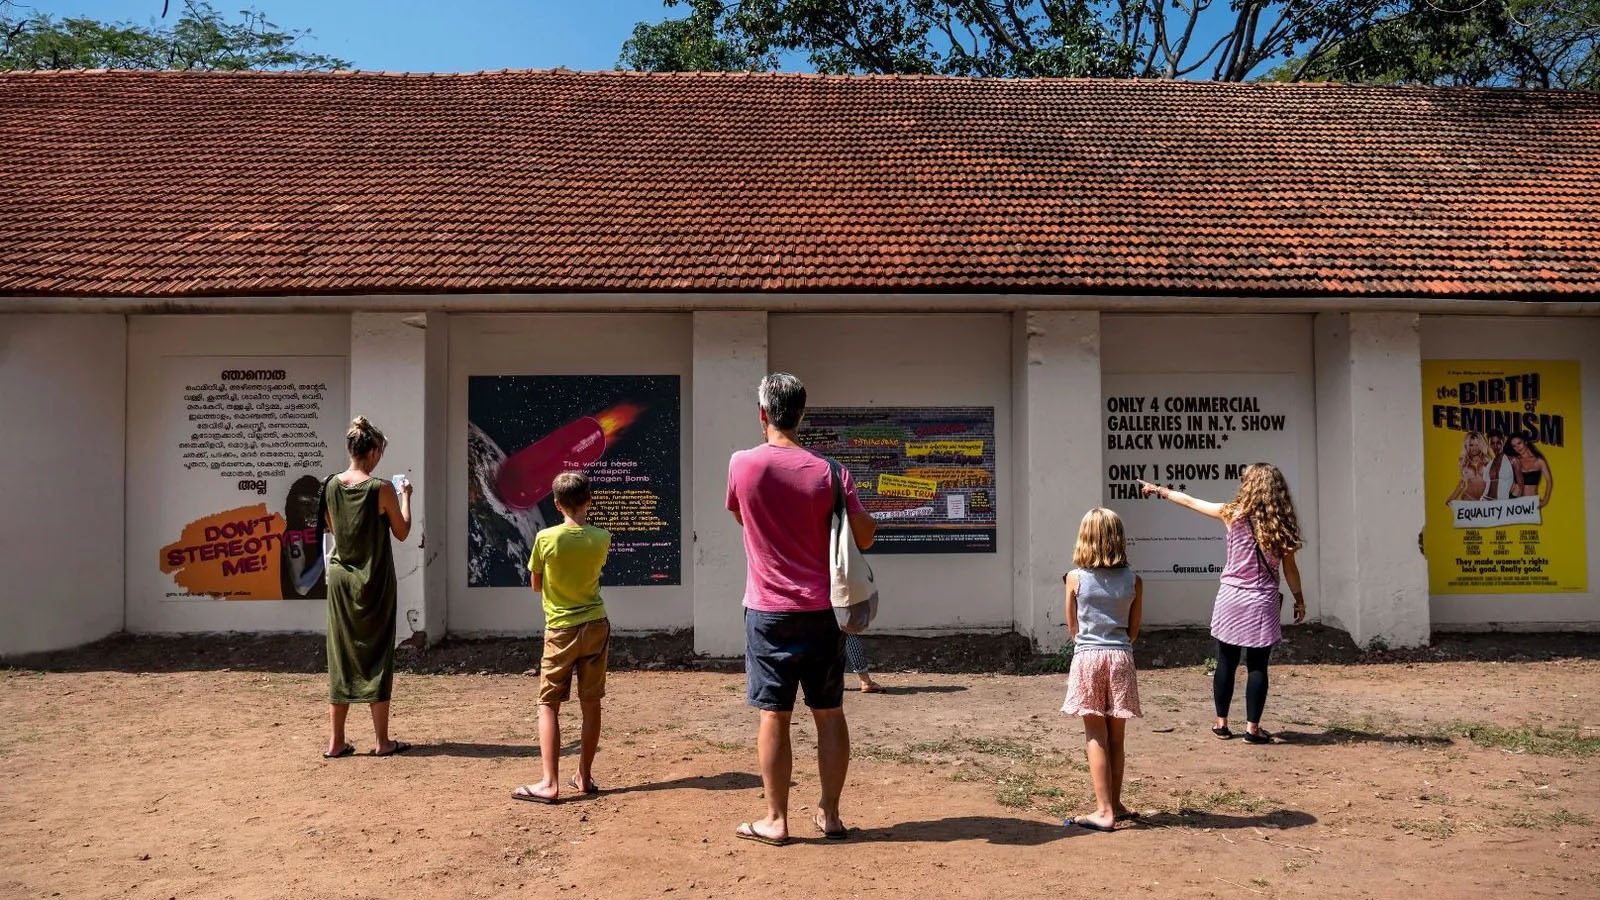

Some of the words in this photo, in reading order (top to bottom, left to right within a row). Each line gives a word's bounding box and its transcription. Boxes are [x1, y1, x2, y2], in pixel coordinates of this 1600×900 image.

[222, 369, 286, 380] ഞാനൊരു
[1436, 384, 1458, 400] the
[1458, 372, 1541, 406] BIRTH
[1107, 397, 1145, 413] ONLY
[1150, 397, 1160, 413] 4
[1164, 397, 1260, 413] COMMERCIAL
[1524, 401, 1538, 413] of
[1107, 415, 1182, 431] GALLERIES
[1187, 415, 1203, 431] IN
[1208, 415, 1237, 431] N.Y.
[1241, 415, 1286, 431] SHOW
[1432, 404, 1565, 449] FEMINISM
[1107, 433, 1154, 450] BLACK
[563, 460, 580, 468] The
[582, 460, 607, 468] world
[610, 460, 639, 468] needs
[588, 475, 623, 484] strogen
[624, 475, 651, 483] Bomb
[593, 468, 631, 477] weapon:
[1108, 464, 1147, 481] ONLY
[1153, 464, 1160, 481] 1
[1166, 464, 1220, 481] SHOWS
[238, 480, 267, 494] അല്ല
[1457, 506, 1503, 521] EQUALITY
[1506, 501, 1535, 517] NOW!
[167, 528, 319, 567] STEREOTYPE
[222, 555, 267, 577] ME!
[1455, 558, 1472, 567] They
[1495, 557, 1527, 565] women's
[1528, 557, 1549, 567] rights
[1461, 565, 1477, 573] look
[1478, 566, 1499, 575] good.
[1500, 565, 1522, 574] Really
[1523, 566, 1544, 575] good.
